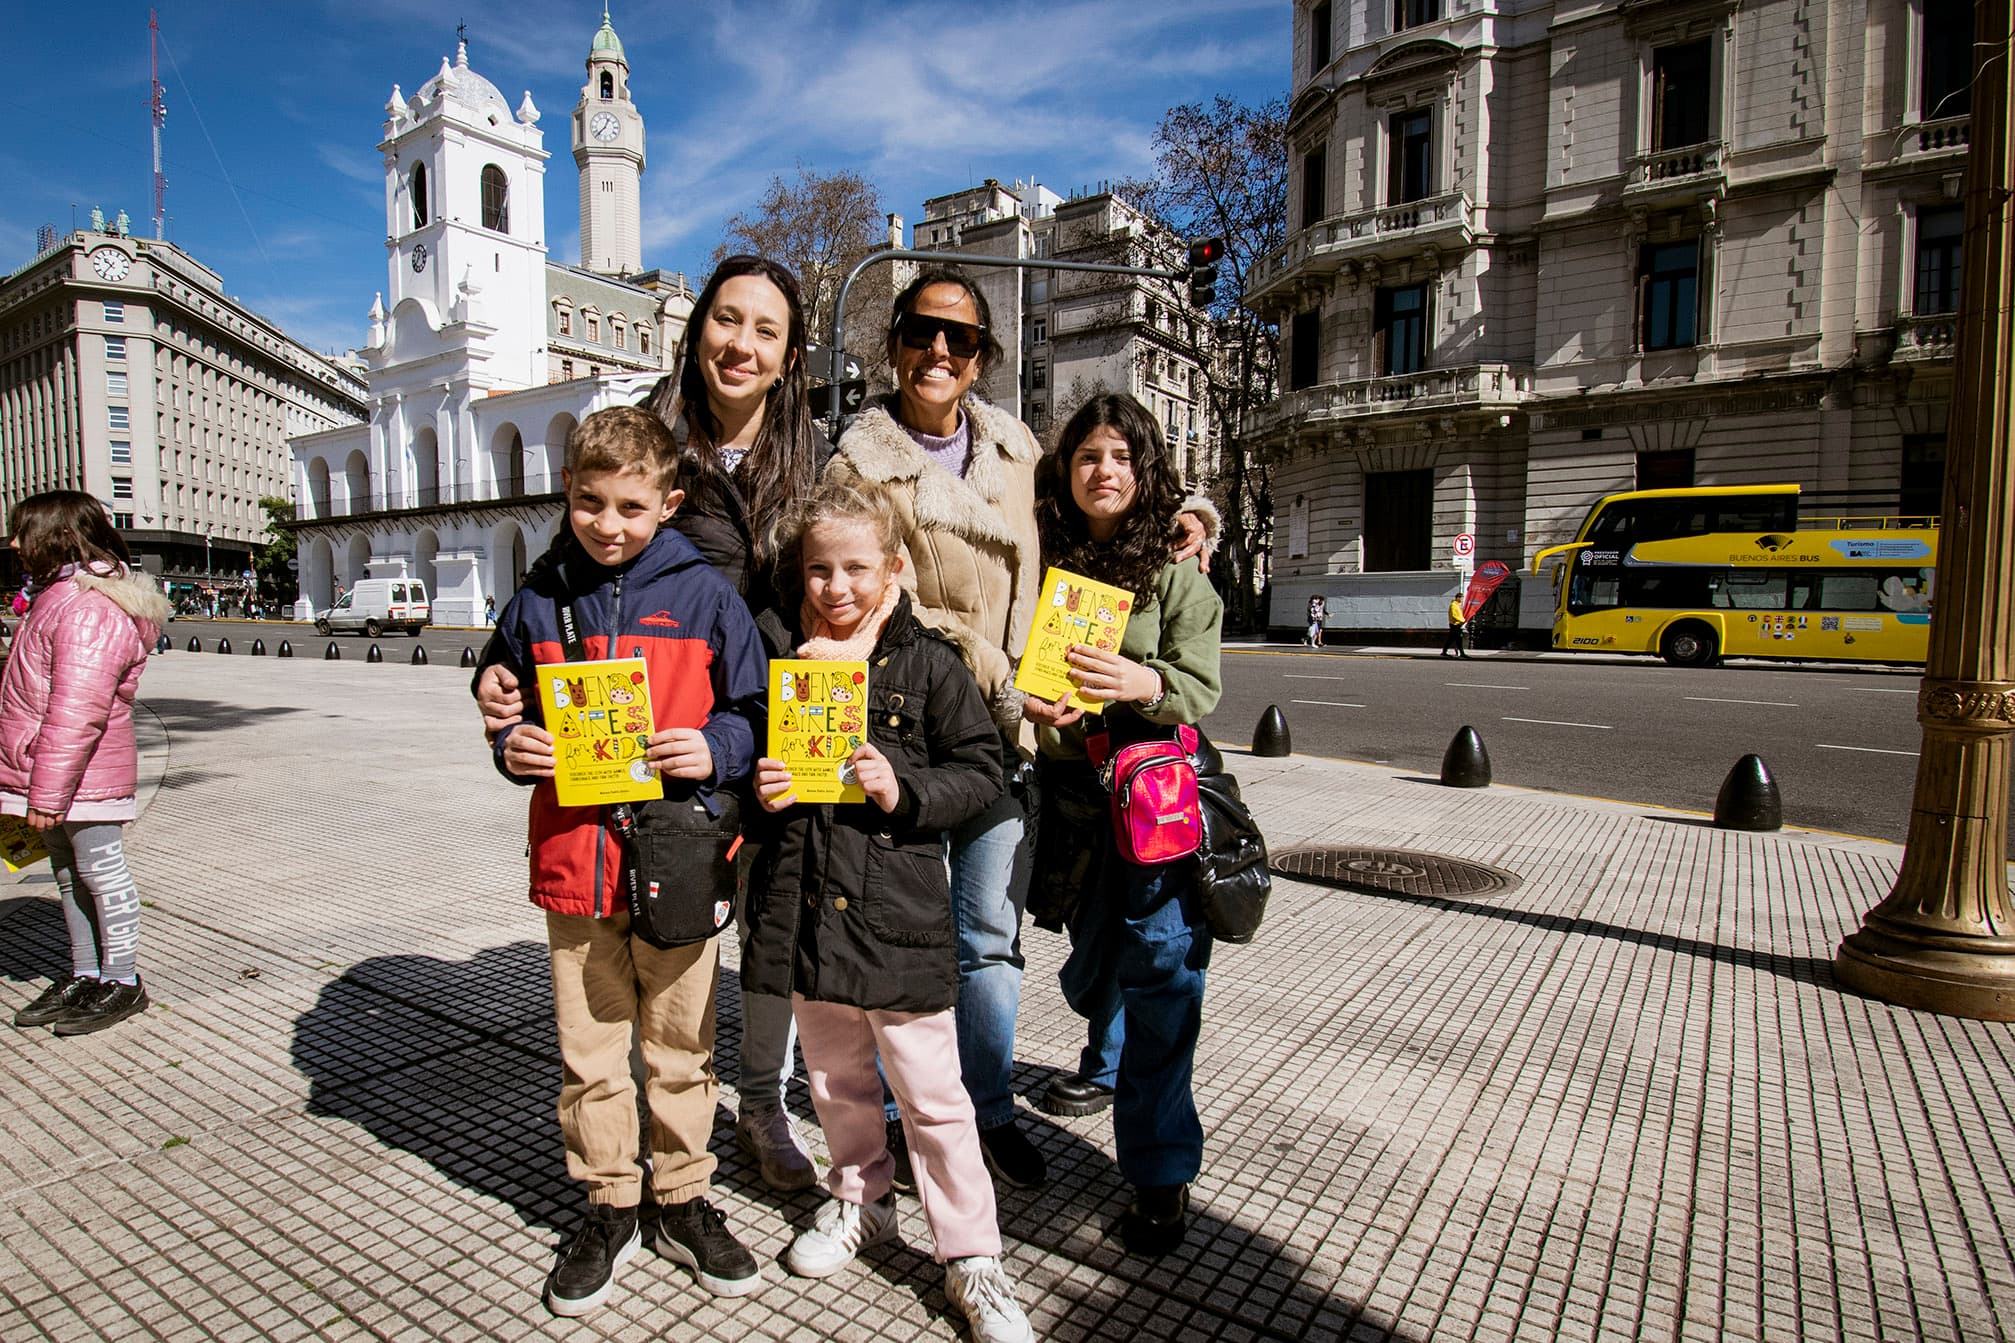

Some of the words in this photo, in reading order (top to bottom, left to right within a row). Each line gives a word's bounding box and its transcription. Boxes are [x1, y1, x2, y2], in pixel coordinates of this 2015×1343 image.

[1729, 554, 1769, 562] BUENOS
[1771, 554, 1798, 562] AIRES
[1800, 554, 1821, 562] BUS
[1572, 637, 1600, 645] 2100
[552, 671, 647, 709] BUENOS
[781, 670, 865, 708] BUENOS
[90, 839, 140, 918] POWER
[106, 918, 140, 965] GIRL
